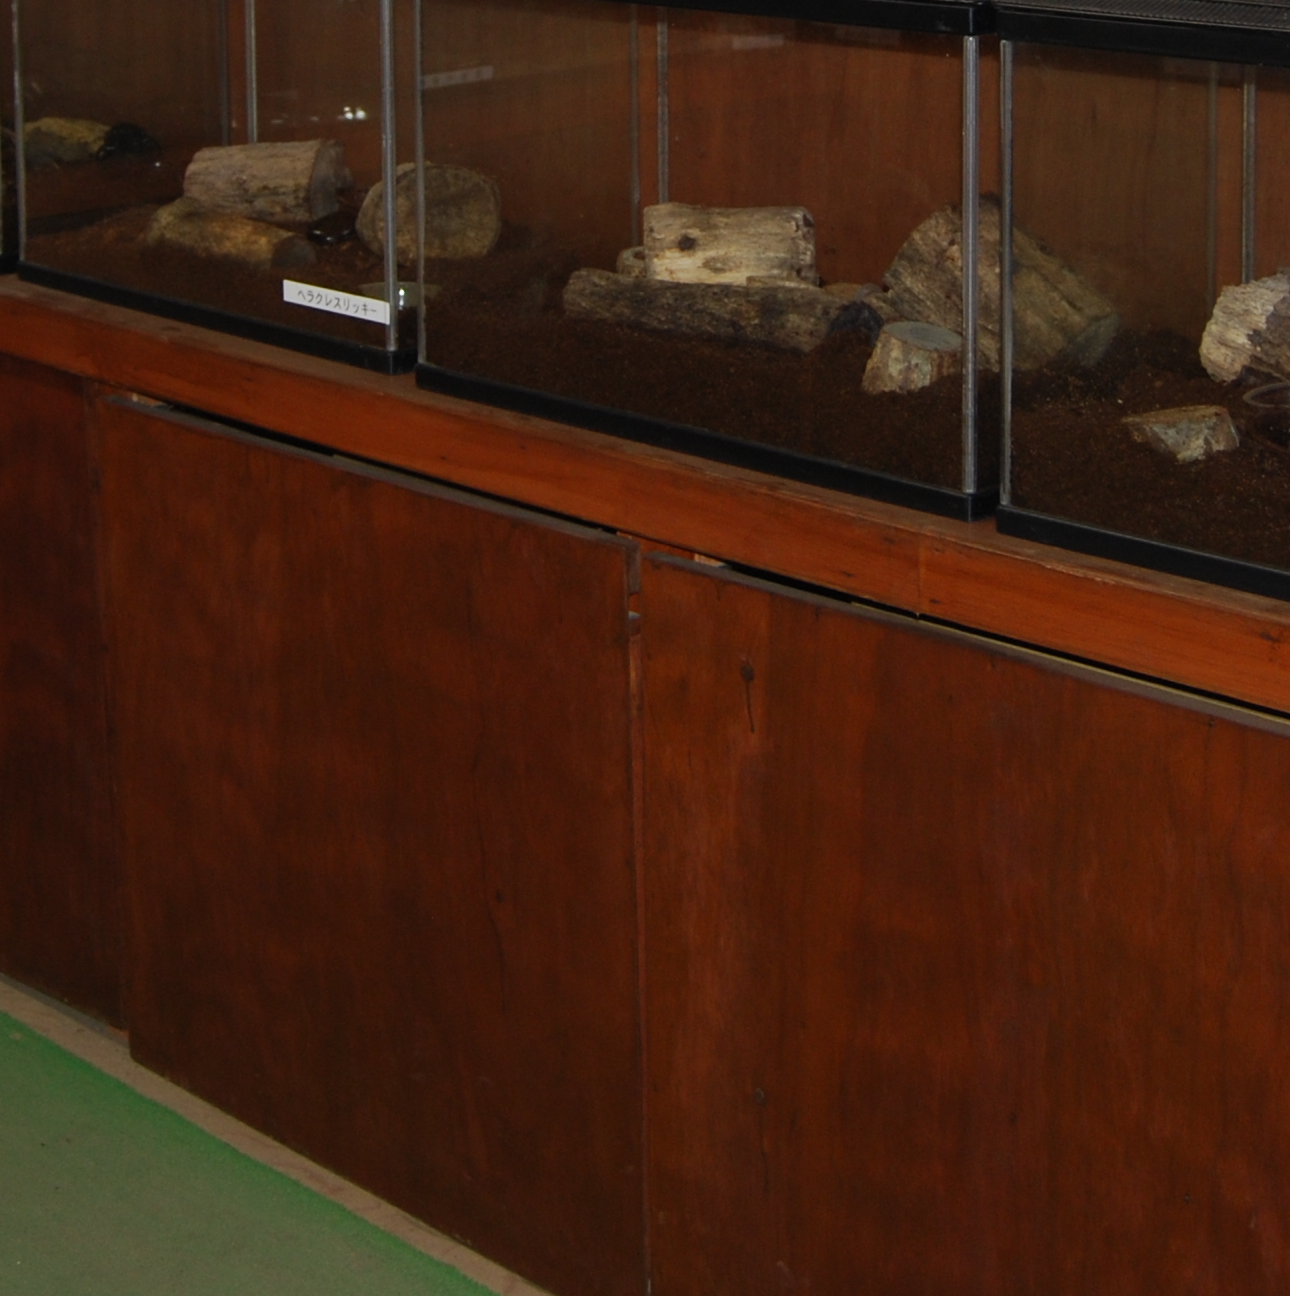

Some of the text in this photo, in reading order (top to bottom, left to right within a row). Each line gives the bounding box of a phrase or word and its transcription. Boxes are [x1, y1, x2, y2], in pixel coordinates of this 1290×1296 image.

[297, 289, 378, 316] ヘラクレスリッキー
